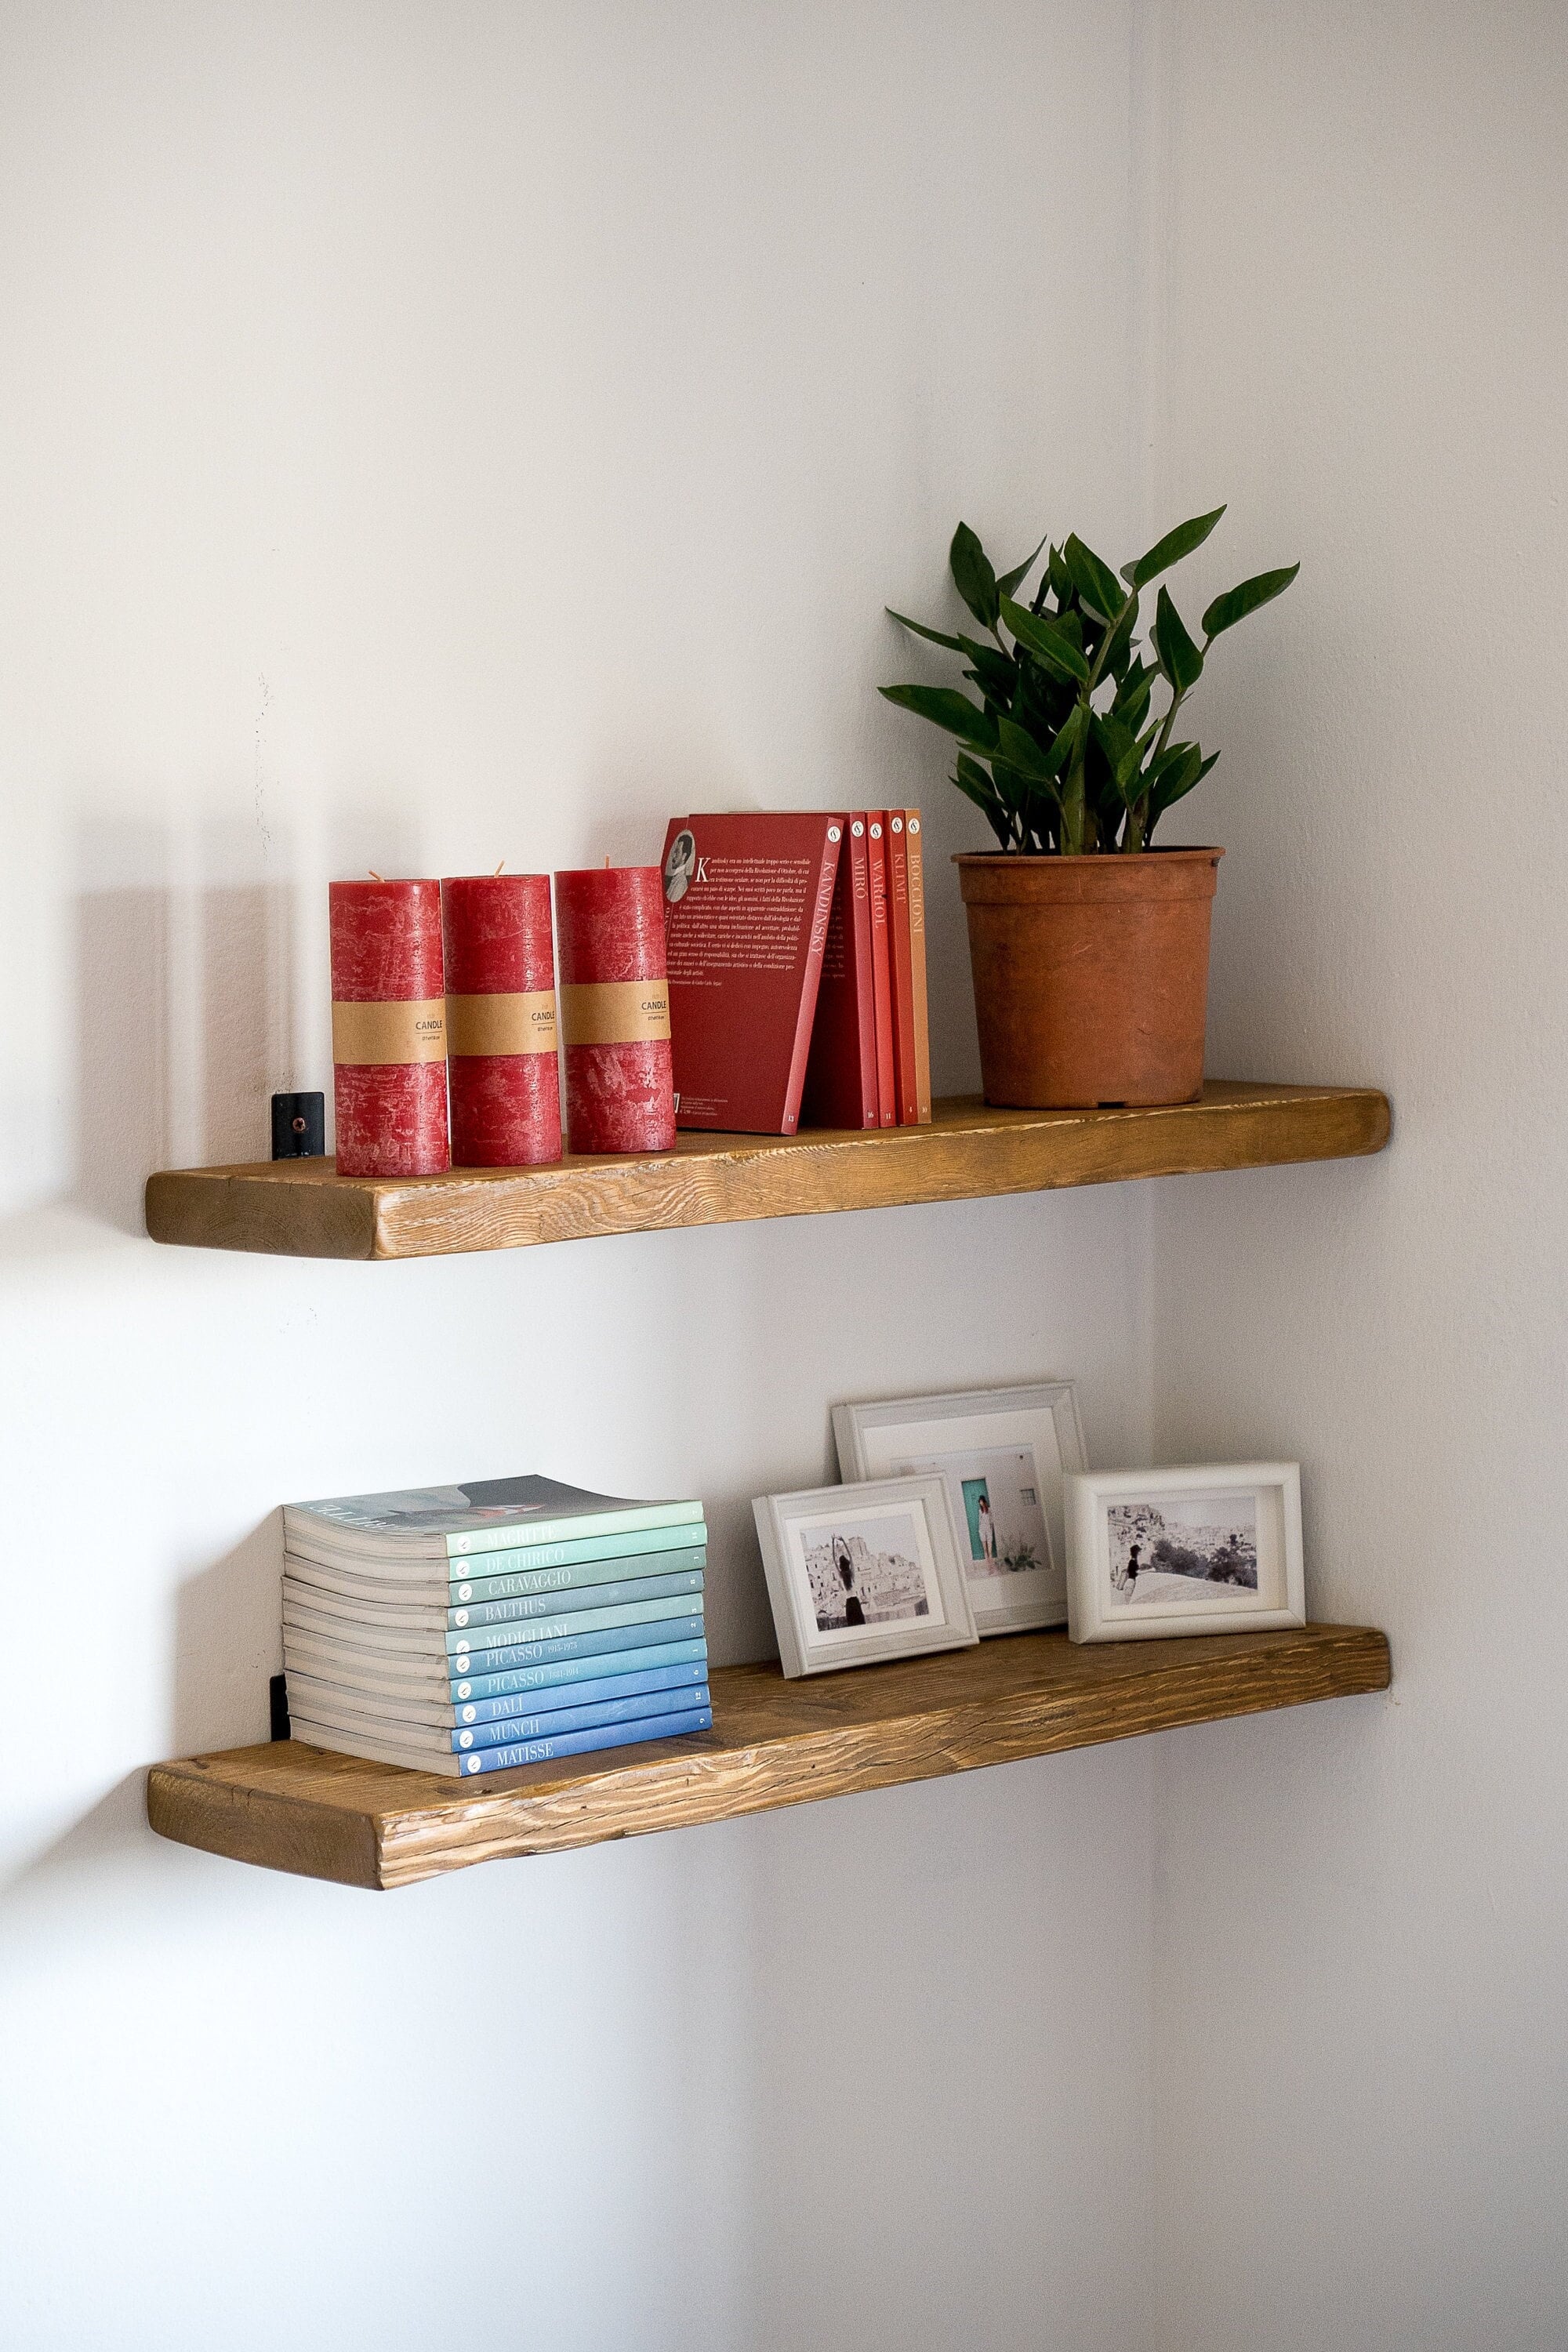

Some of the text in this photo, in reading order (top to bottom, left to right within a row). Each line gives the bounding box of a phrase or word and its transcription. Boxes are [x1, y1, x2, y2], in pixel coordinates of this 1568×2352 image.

[895, 853, 906, 904] KLIMT
[873, 858, 886, 929] WARHOL
[910, 854, 924, 934] BOCCIONI
[810, 862, 836, 956] KANDINSKY
[532, 1011, 555, 1021] CANDLE
[641, 1000, 667, 1010] CANDLE
[416, 1020, 443, 1029] CANDLE
[487, 1525, 557, 1547] MAGRITTE
[486, 1548, 564, 1572] DE CHIRICO
[488, 1570, 572, 1595] CARAVAGGIO
[485, 1599, 546, 1621] BALTHUS
[486, 1624, 568, 1648] MODIGLIANI
[486, 1644, 543, 1668] PICASSO
[488, 1670, 545, 1693] PICASSO
[492, 1693, 524, 1717] DALÍ
[695, 1692, 702, 1700] 12
[490, 1719, 540, 1743] MUNCH
[497, 1742, 554, 1767] MATISSE
